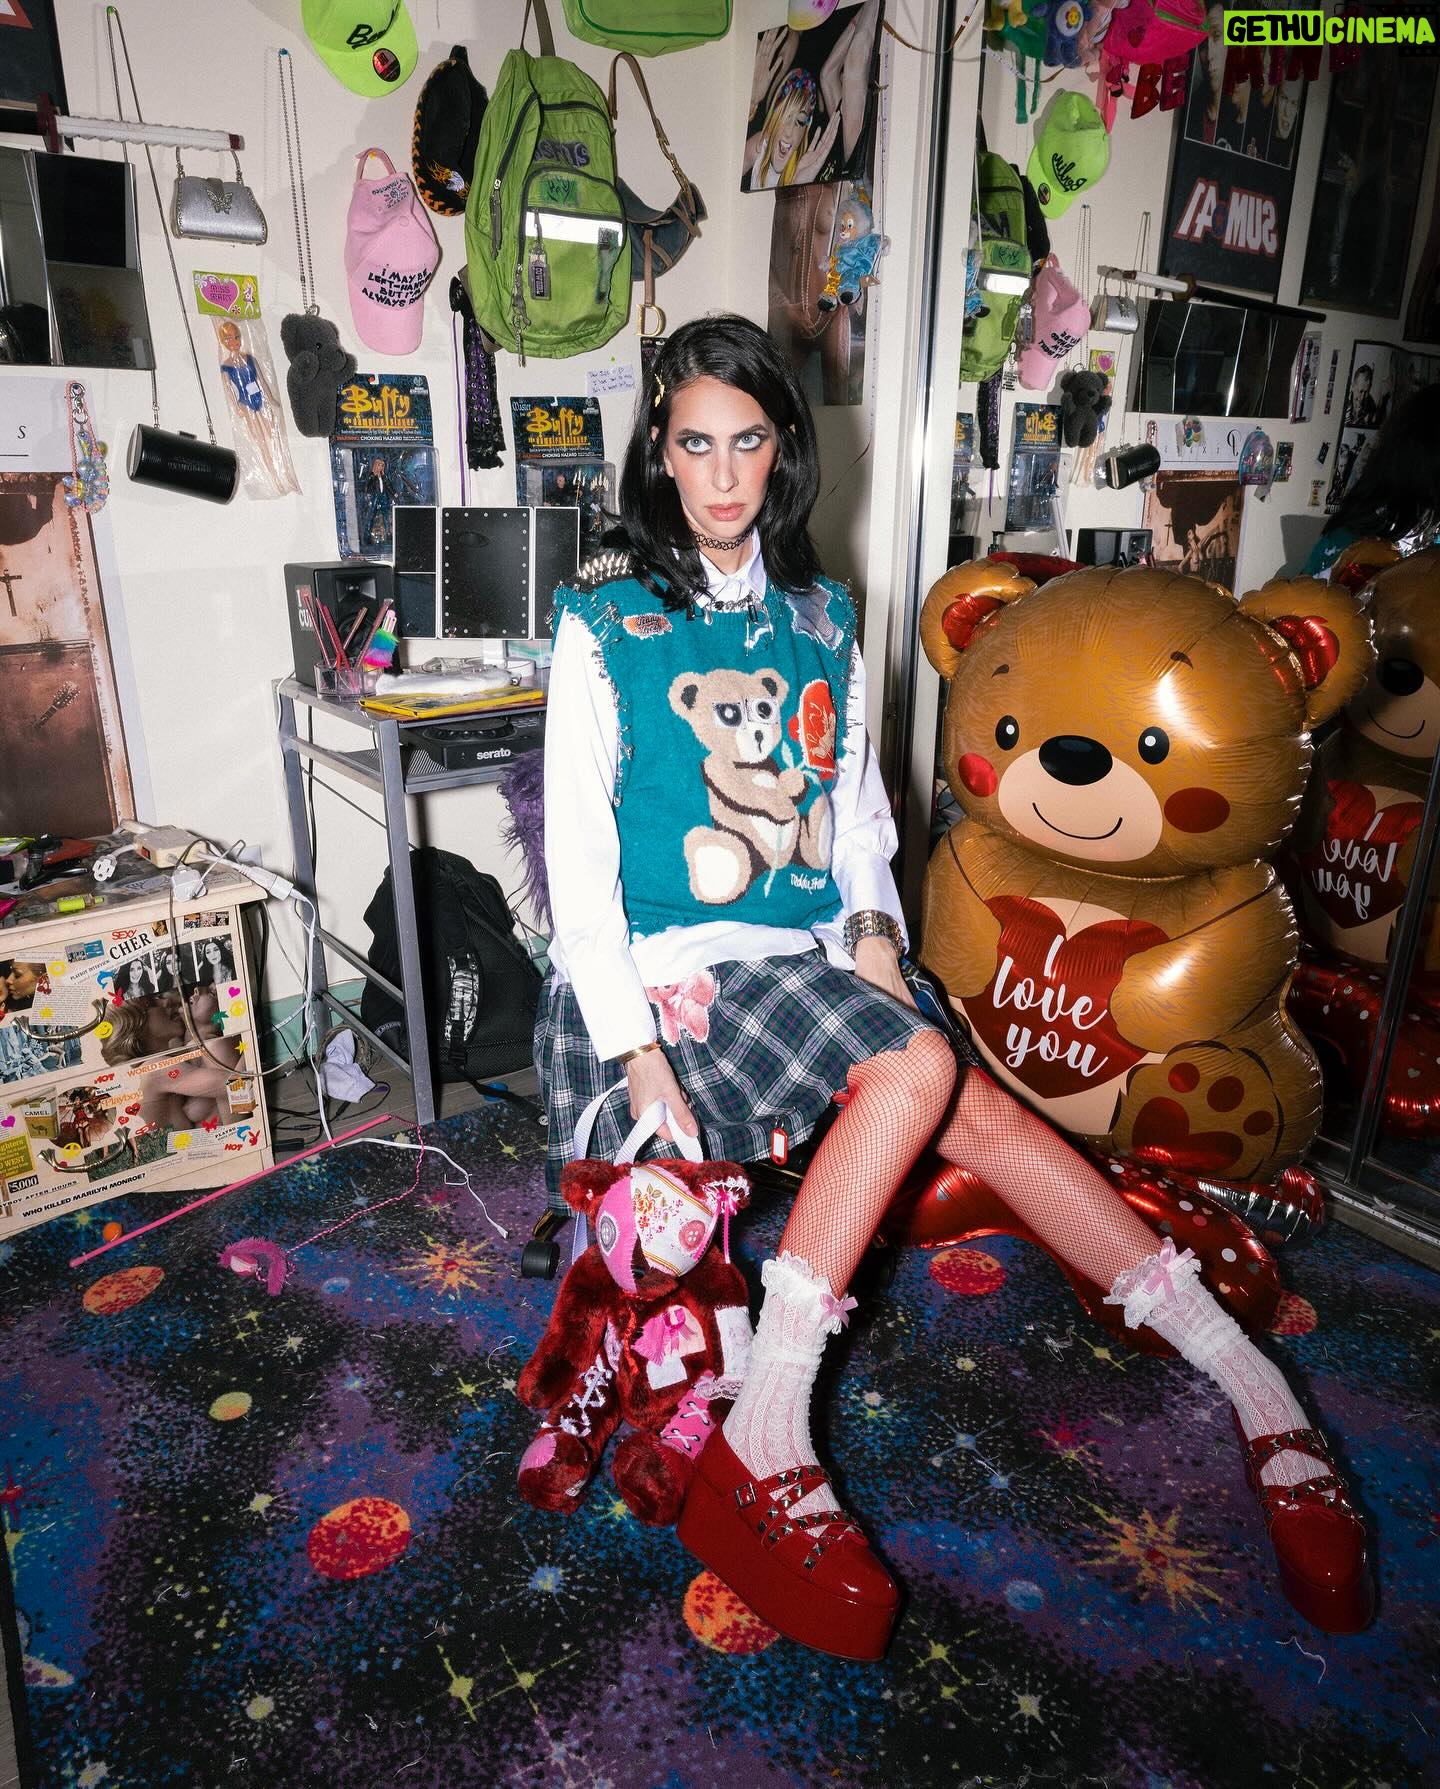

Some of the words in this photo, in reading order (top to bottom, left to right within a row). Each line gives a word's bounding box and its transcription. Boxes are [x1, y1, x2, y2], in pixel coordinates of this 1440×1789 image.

[362, 288, 406, 308] ALWAYS
[380, 286, 402, 299] BUT
[341, 384, 411, 417] Buffy
[526, 407, 584, 436] Buffy
[476, 747, 511, 760] serato
[109, 932, 152, 960] CHER
[112, 929, 138, 940] SEXY
[1043, 934, 1065, 977] I
[993, 955, 1108, 1031] love
[1006, 1023, 1109, 1078] you
[127, 1063, 158, 1077] WORLD
[22, 1207, 43, 1218] WHO
[44, 1197, 71, 1210] KILLED
[73, 1185, 108, 1201] MARILYN
[109, 1173, 146, 1189] MONROE?
[25, 1189, 49, 1199] AFTER
